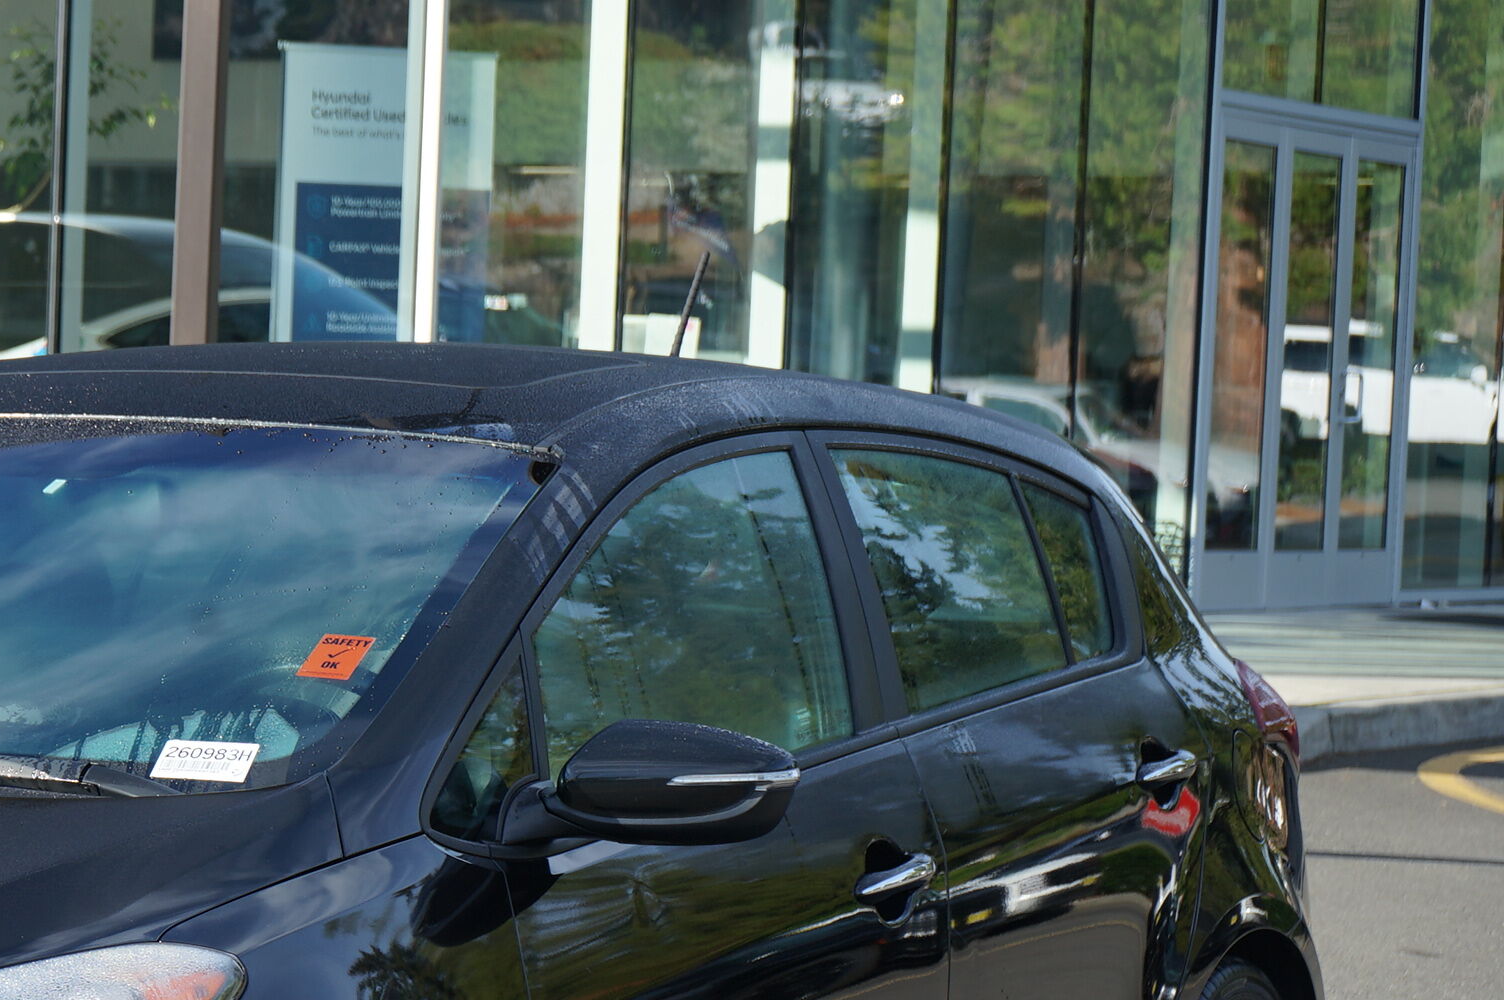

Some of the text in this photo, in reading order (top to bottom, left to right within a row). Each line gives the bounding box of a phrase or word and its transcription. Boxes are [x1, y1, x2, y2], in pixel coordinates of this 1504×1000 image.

[311, 88, 370, 105] Hyundai
[311, 106, 405, 122] Certified Used
[312, 126, 330, 137] The
[332, 127, 353, 138] best
[321, 637, 372, 648] SAFETY
[320, 660, 341, 670] OK
[164, 746, 253, 762] 260983H
